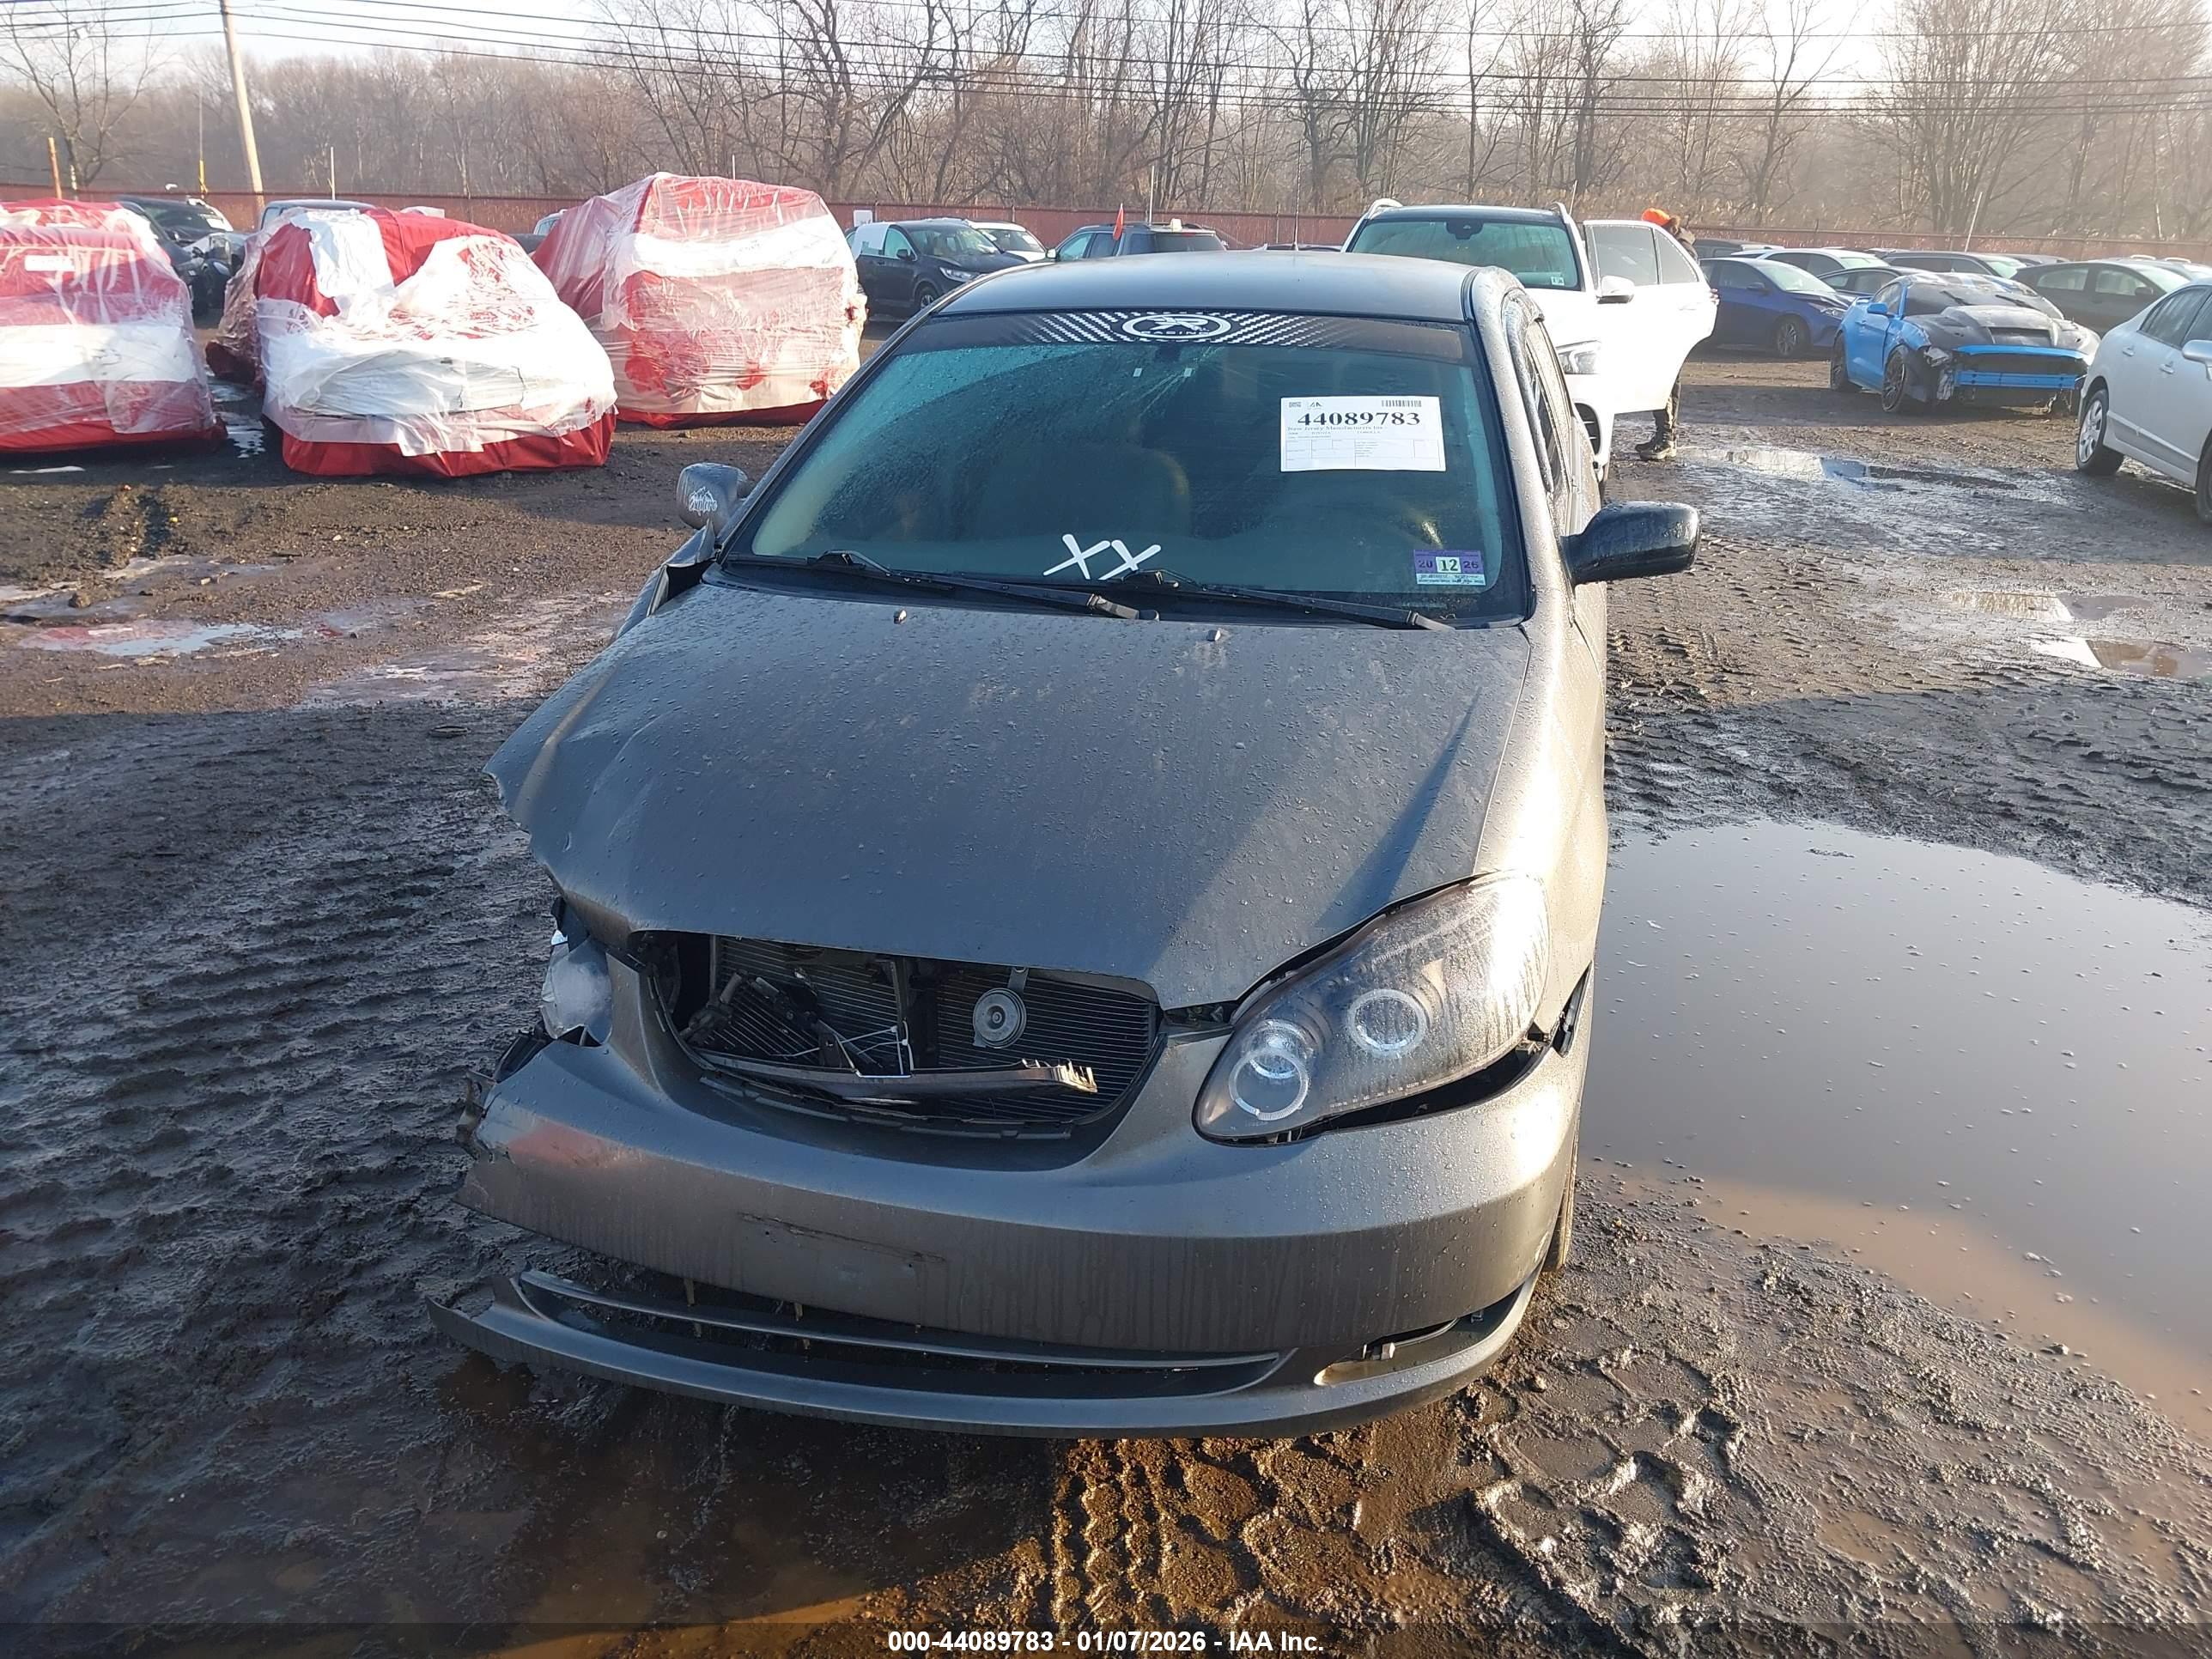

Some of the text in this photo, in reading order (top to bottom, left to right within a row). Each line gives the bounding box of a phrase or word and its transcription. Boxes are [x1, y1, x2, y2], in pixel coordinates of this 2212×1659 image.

[1297, 411, 1420, 426] 44089783
[1418, 559, 1479, 572] 20 12 26
